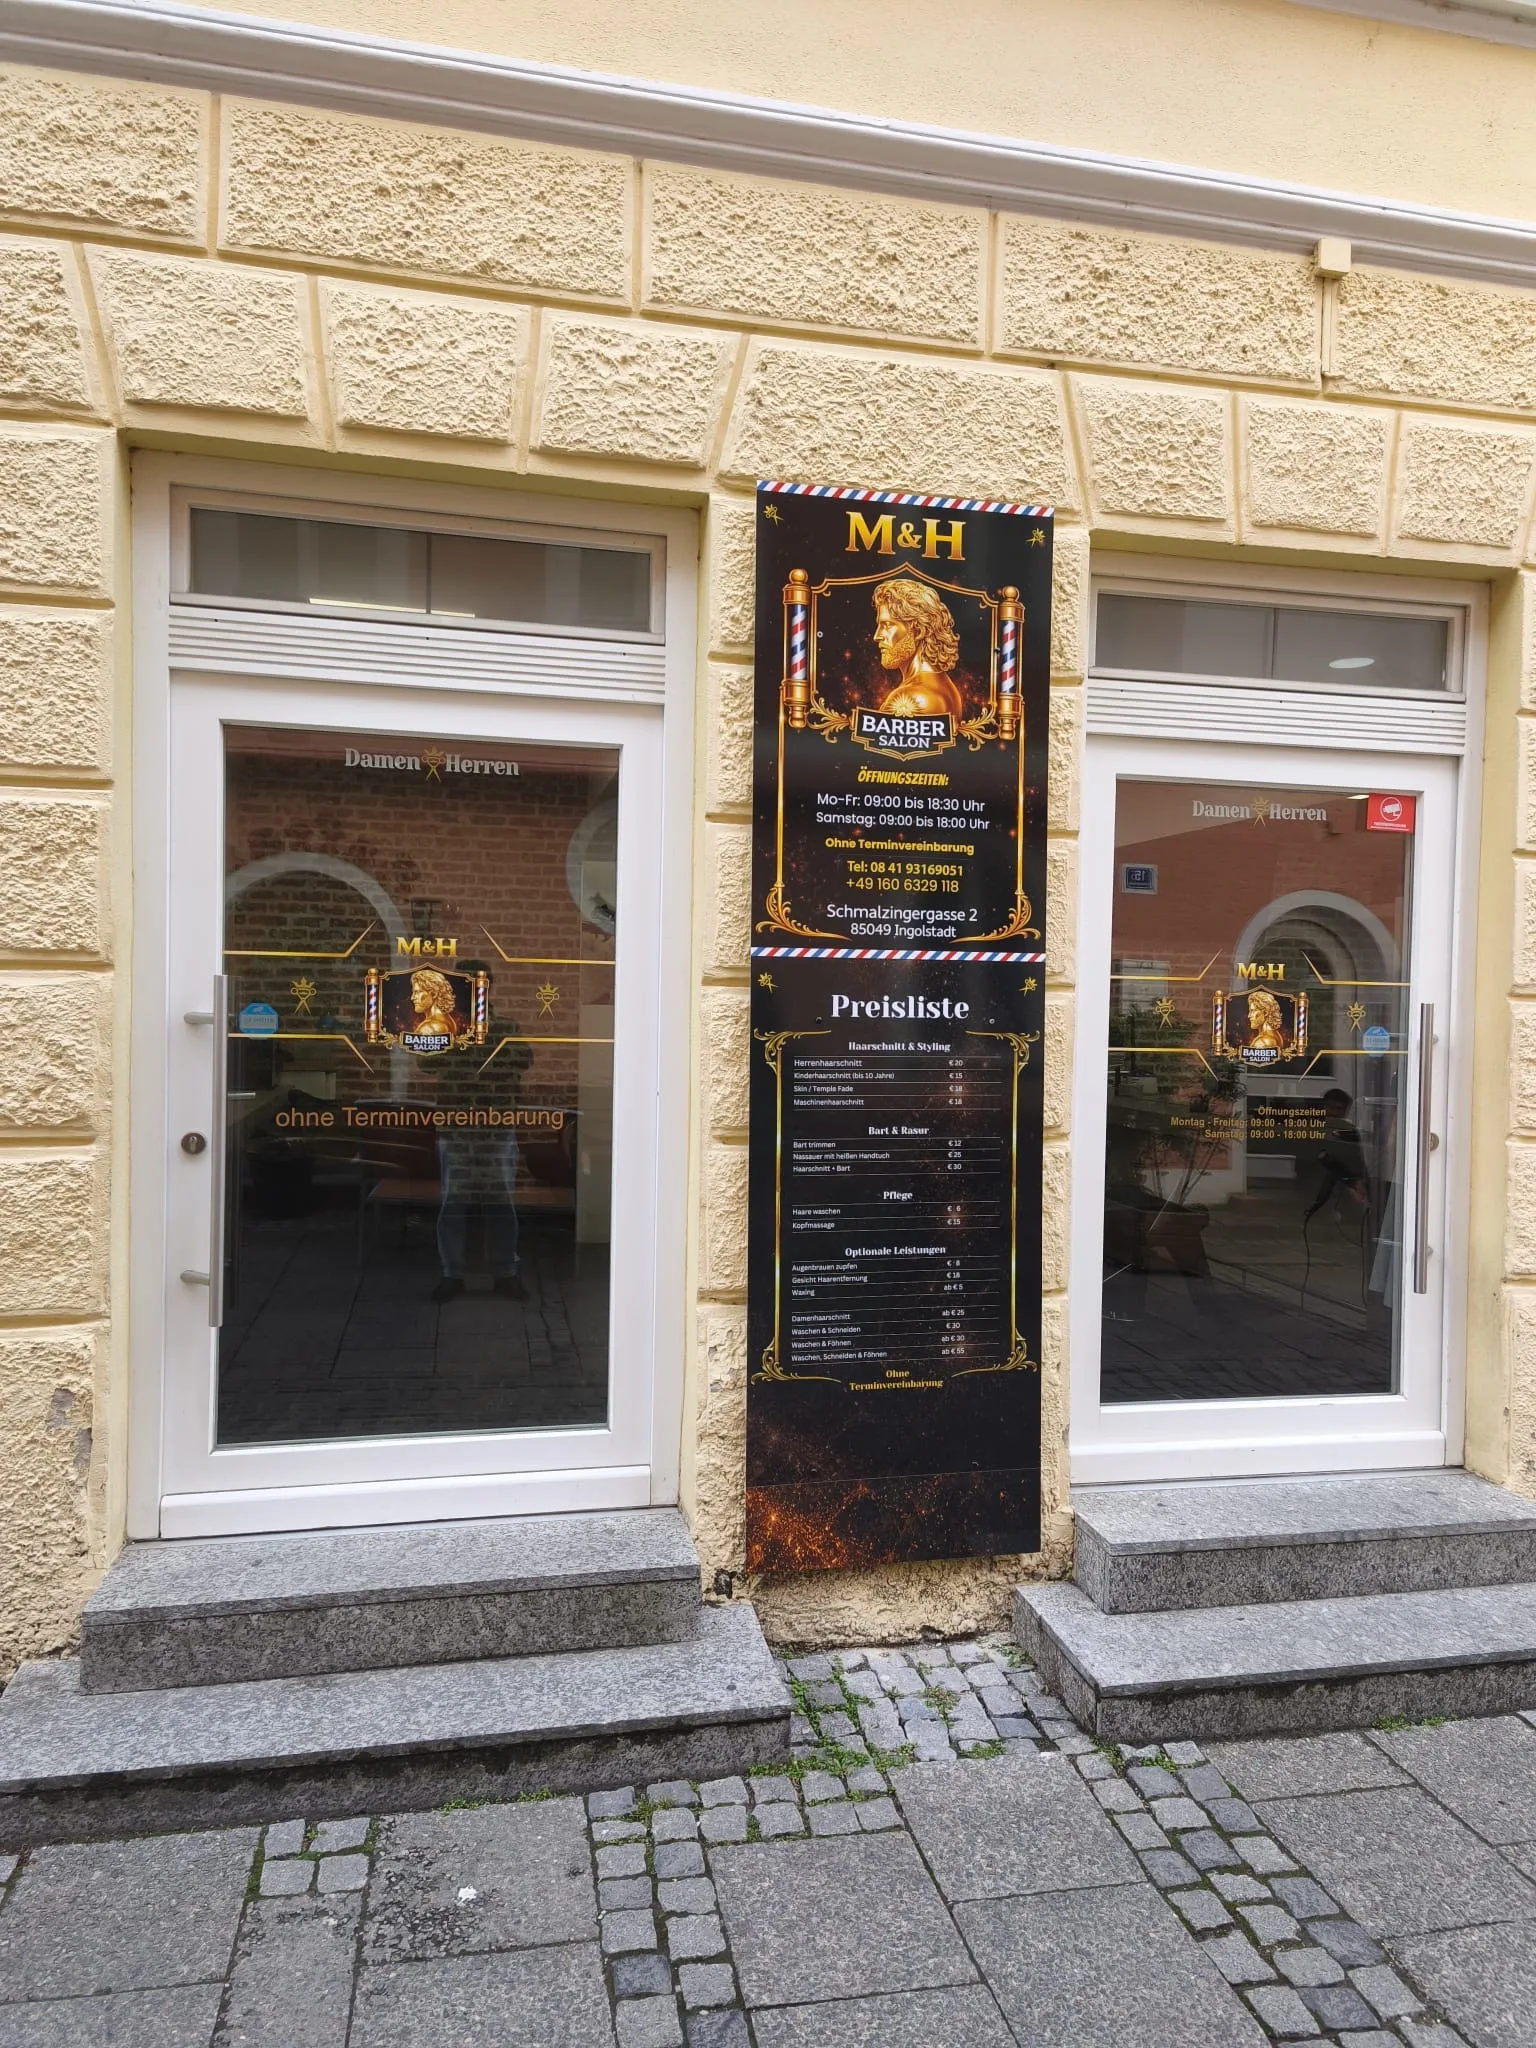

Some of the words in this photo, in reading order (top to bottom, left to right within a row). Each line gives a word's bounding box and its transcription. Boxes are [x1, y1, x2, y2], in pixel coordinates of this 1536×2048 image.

[845, 511, 966, 562] M&H
[861, 713, 946, 738] BARBER
[877, 734, 931, 749] SALON
[345, 747, 421, 771] Damen
[445, 753, 520, 776] Herren
[857, 766, 949, 786] ÖFFNUNGSZEITEN:
[817, 793, 861, 807] Mo-Fr:
[864, 794, 901, 808] 09:00
[904, 796, 924, 810] bis
[927, 797, 959, 811] 18:30
[962, 799, 986, 812] Uhr
[1192, 800, 1250, 819] Damen
[1269, 803, 1327, 821] Herren
[816, 812, 876, 828] Samstag:
[879, 814, 913, 826] 09:00
[915, 816, 934, 827] bis
[936, 816, 966, 829] 18:00
[969, 818, 990, 830] Uhr
[825, 837, 856, 849] Ohne
[857, 839, 975, 856] Terminvereinbarung
[847, 860, 868, 873] Tel:
[870, 862, 885, 873] 08
[888, 862, 902, 874] 41
[905, 863, 963, 877] 93169051
[846, 877, 874, 890] +49
[877, 878, 900, 891] 160
[904, 879, 938, 892] 6329
[941, 880, 959, 893] 118
[826, 904, 966, 923] Schmalzingergasse
[969, 908, 978, 922] 2
[850, 923, 892, 936] 85049
[894, 924, 957, 939] Ingolstadt
[395, 936, 459, 958] M&H
[1237, 962, 1285, 981] M&H
[831, 994, 970, 1019] Preisliste
[405, 1034, 449, 1045] BARBER
[848, 1041, 906, 1051] Haarschnitt
[908, 1042, 916, 1051] &
[917, 1041, 951, 1053] Styling
[1243, 1048, 1277, 1057] BARBER
[794, 1059, 862, 1067] Herrenhaarschnitt
[794, 1072, 851, 1080] Kinderhaarschnitt
[852, 1072, 864, 1080] (bis
[875, 1072, 895, 1080] Jahre)
[813, 1085, 836, 1093] Temple
[793, 1098, 865, 1106] Maschinenhaarschnitt
[275, 1107, 335, 1128] ohne
[342, 1106, 564, 1130] Terminvereinbarung
[1258, 1106, 1326, 1118] Öffnungszeiten
[1170, 1116, 1205, 1127] Montag
[1250, 1118, 1275, 1127] 09:00
[1283, 1119, 1308, 1128] 19:00
[1309, 1119, 1326, 1128] Uhr
[868, 1126, 889, 1135] Bart
[891, 1126, 899, 1135] &
[901, 1126, 930, 1135] Rasur
[1250, 1130, 1275, 1139] 09:00
[1283, 1130, 1307, 1139] 18:00
[1309, 1130, 1326, 1139] Uhr
[793, 1141, 807, 1149] Bart
[836, 1164, 850, 1172] Bart
[883, 1191, 913, 1201] Pflege
[792, 1221, 835, 1230] Kopfmassage
[845, 1247, 892, 1258] Optionale
[894, 1246, 946, 1256] Leistungen
[792, 1263, 835, 1272] Augenbrauen
[835, 1263, 858, 1271] zupfen
[792, 1276, 817, 1284] Gesicht
[817, 1275, 868, 1283] Haarentfernung
[792, 1288, 815, 1297] Waxing
[792, 1313, 850, 1322] Damenhaarschnitt
[941, 1309, 950, 1317] ab
[792, 1328, 821, 1336] Waschen
[827, 1326, 861, 1334] Schneiden
[792, 1341, 821, 1349] Waschen
[827, 1339, 852, 1347] Föhnen
[792, 1354, 822, 1362] Waschen,
[823, 1352, 857, 1361] Schneiden
[863, 1350, 888, 1358] Föhnen
[885, 1369, 910, 1378] Ohne
[848, 1379, 944, 1391] Terminvereinbarung
